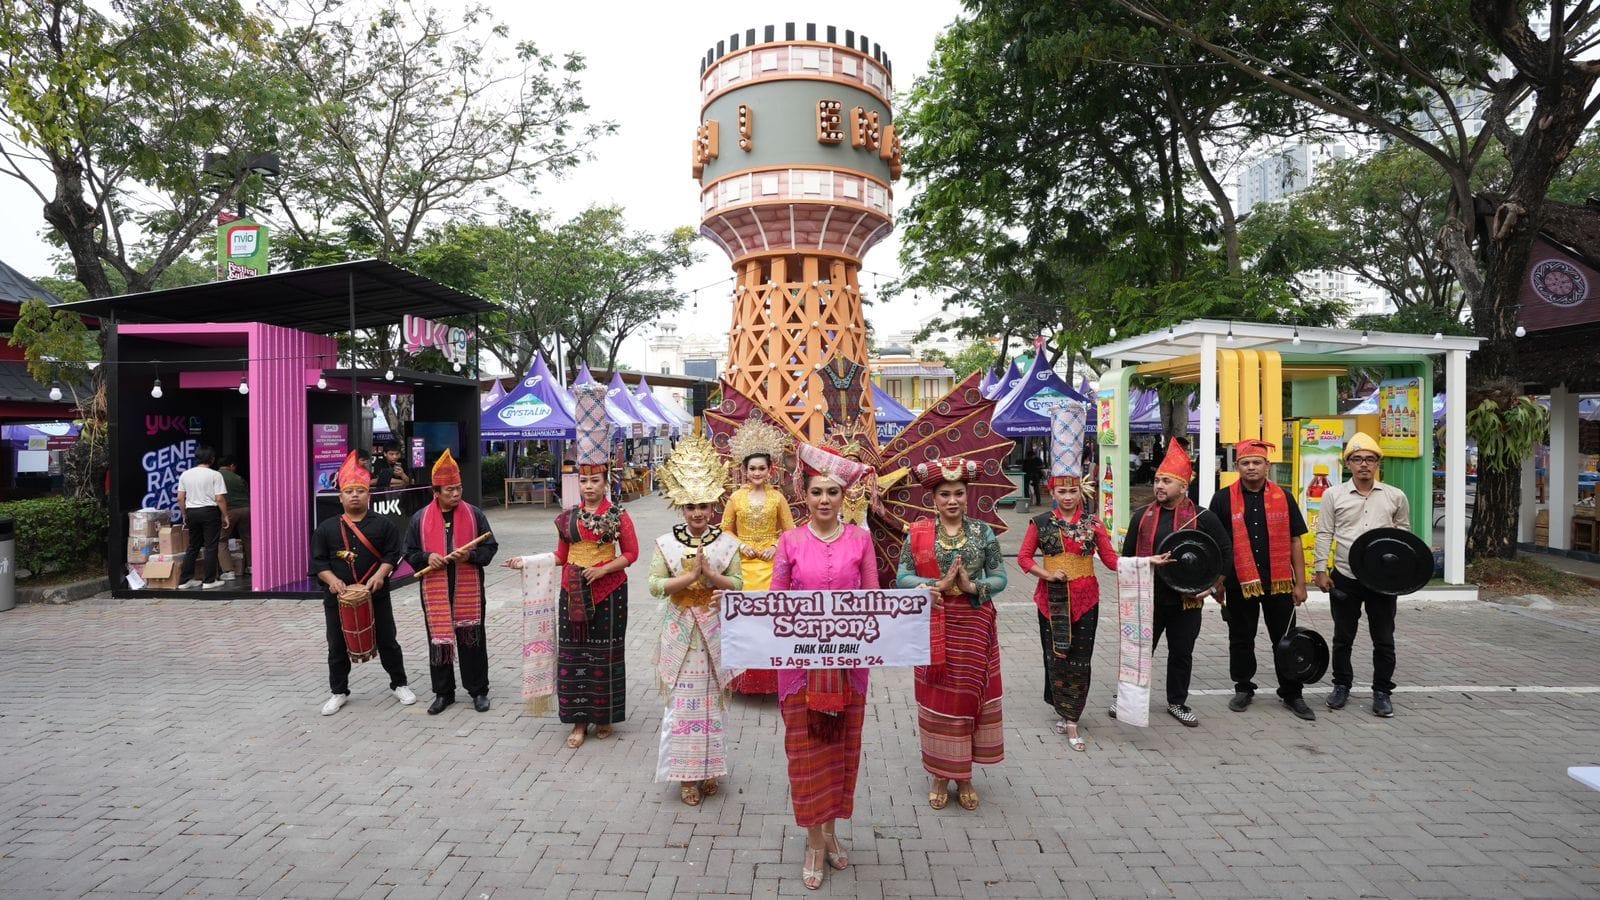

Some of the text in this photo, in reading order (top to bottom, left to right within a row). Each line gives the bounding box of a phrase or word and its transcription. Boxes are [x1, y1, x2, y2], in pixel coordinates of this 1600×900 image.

[142, 439, 197, 472] GENE
[725, 591, 927, 620] Festival Kuliner
[774, 615, 880, 643] Serpong
[770, 657, 782, 666] 15
[786, 657, 810, 668] Ags
[822, 657, 834, 666] 15
[837, 657, 861, 668] Sep
[794, 643, 860, 654] ENAK KALI BAH!
